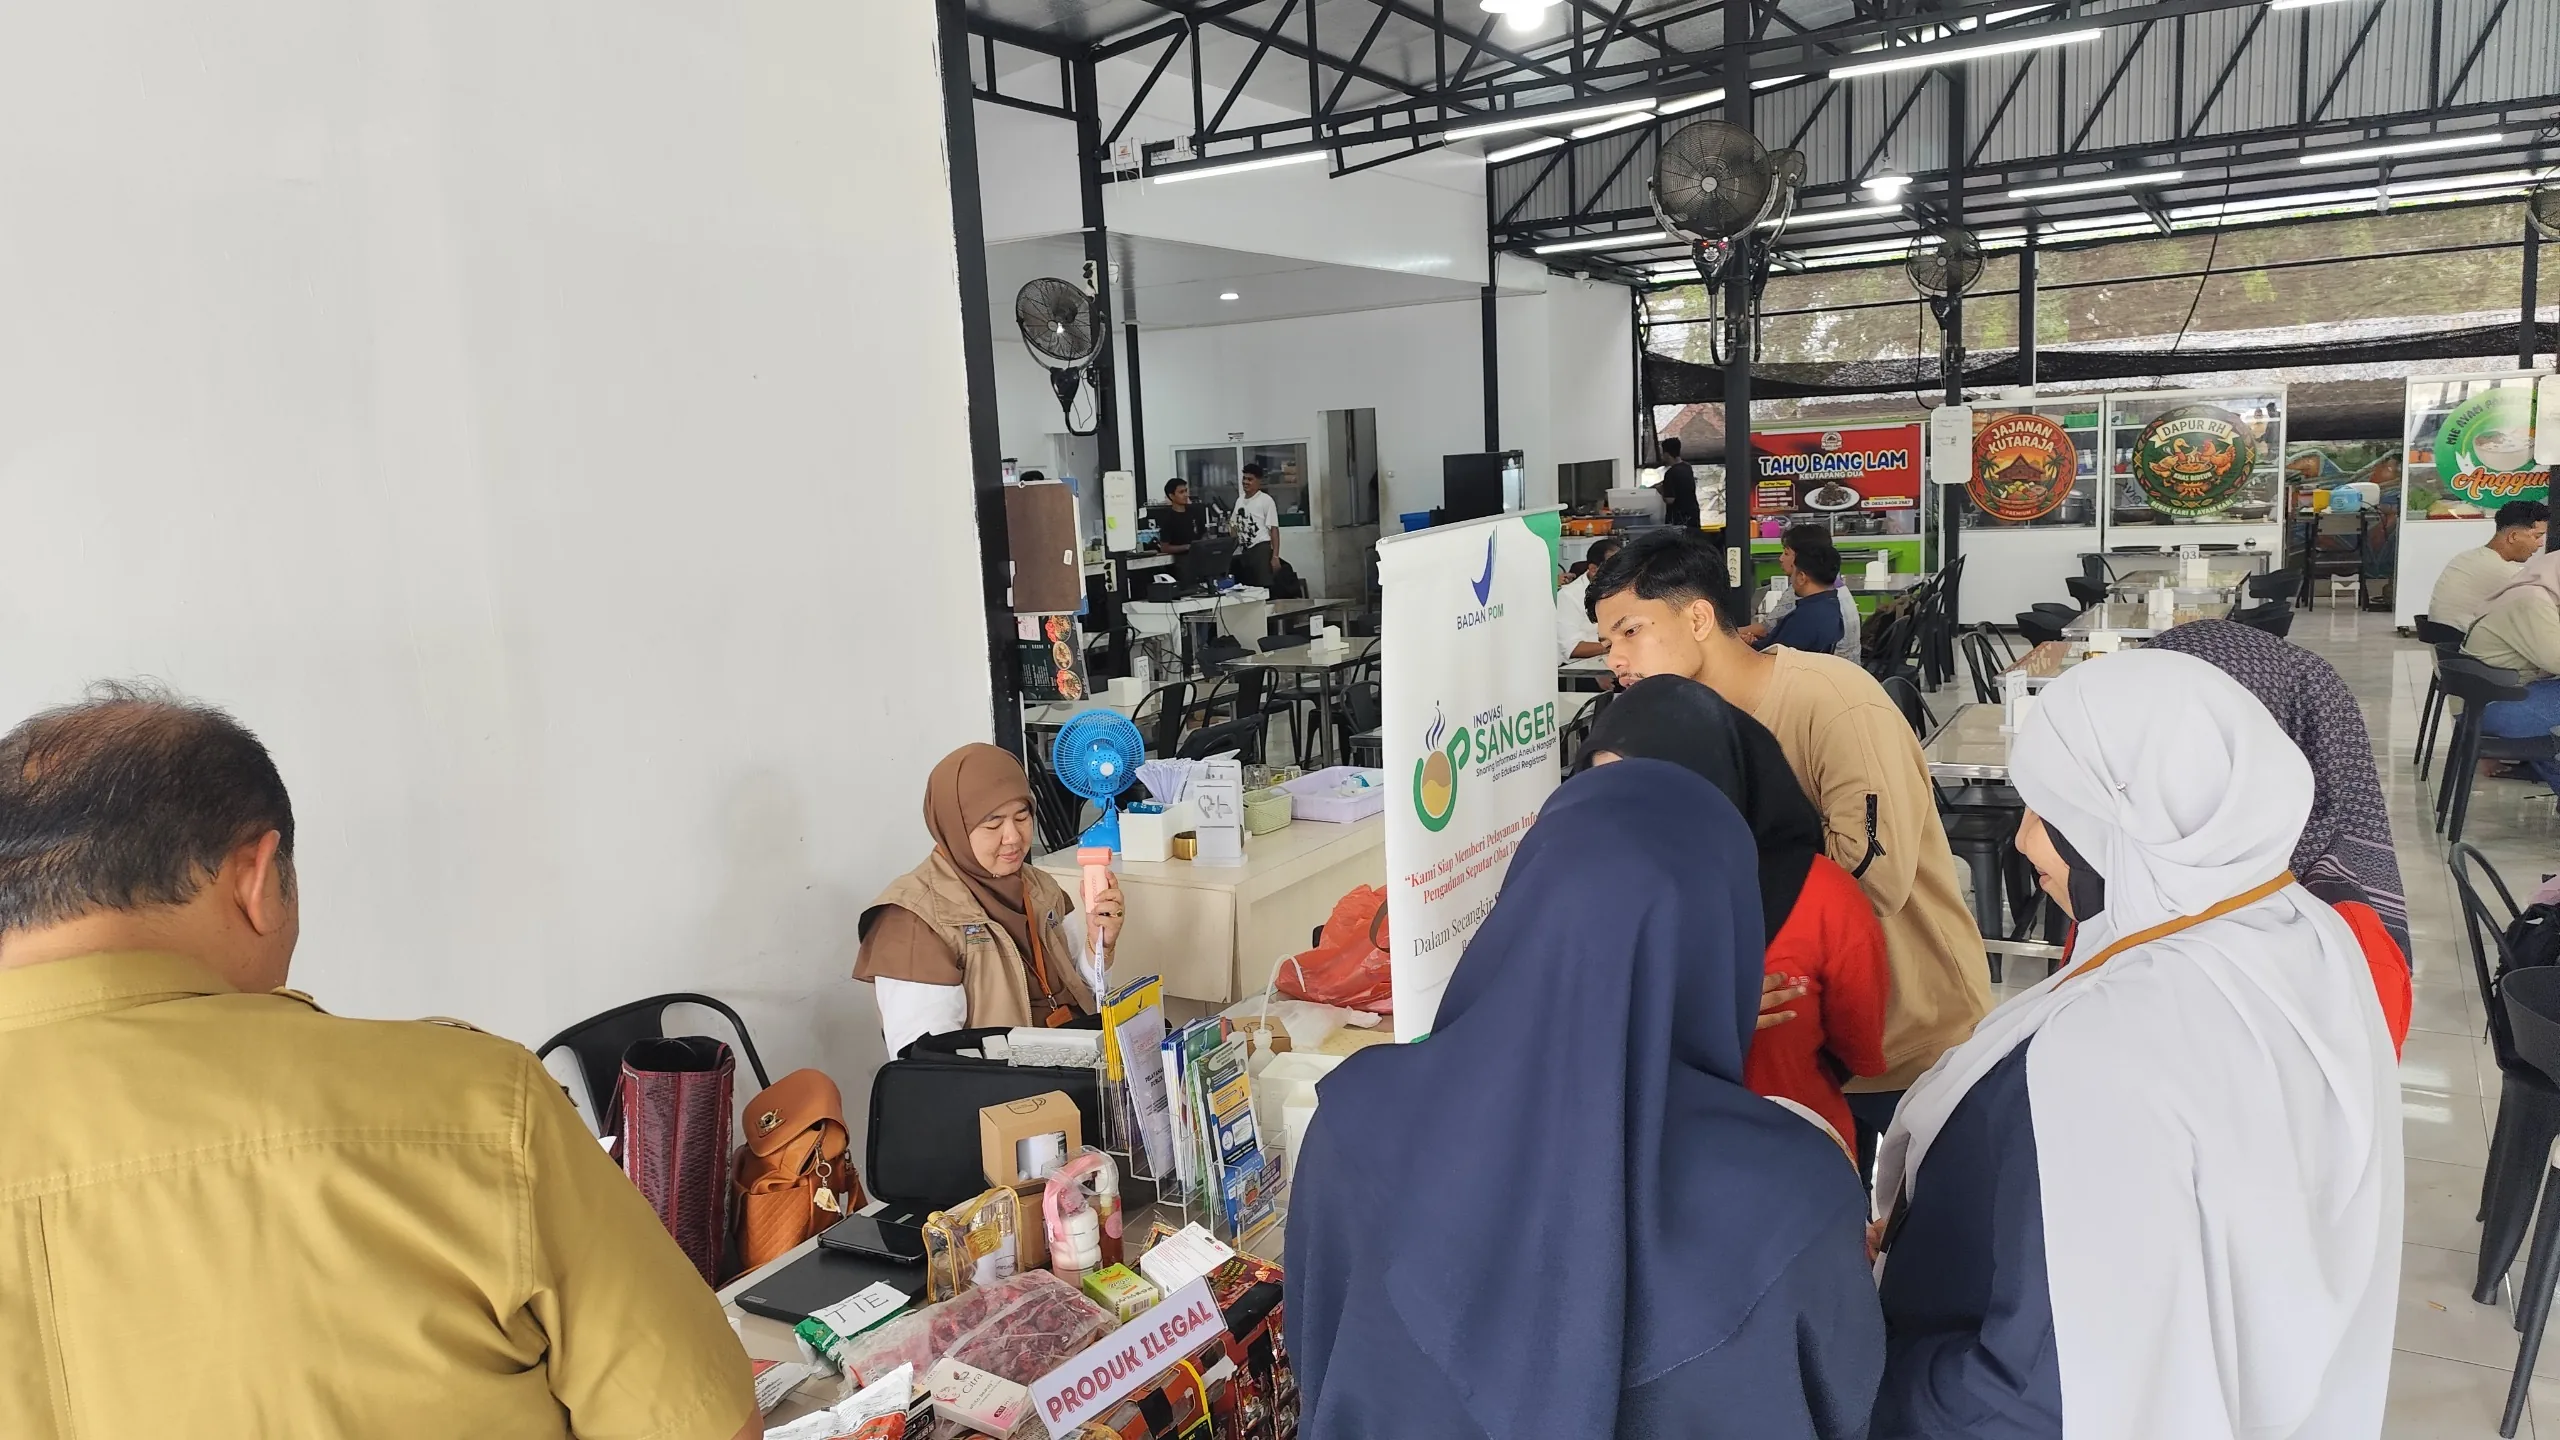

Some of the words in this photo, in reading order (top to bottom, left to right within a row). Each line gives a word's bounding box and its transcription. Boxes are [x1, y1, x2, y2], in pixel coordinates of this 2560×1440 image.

[1991, 420, 2053, 440] JAJANAN
[2162, 419, 2205, 437] DAPUR
[2208, 421, 2227, 435] RH
[2446, 428, 2461, 446] MIE
[1988, 435, 2055, 454] KUTARAJA
[1758, 454, 1809, 476] TAHU
[1811, 452, 1864, 473] BANG
[1865, 449, 1909, 471] LAM
[1799, 472, 1846, 480] KEUTAPANG
[2181, 550, 2197, 561] 03
[1456, 608, 1487, 631] BADAN
[1488, 603, 1504, 620] POM
[1473, 704, 1503, 728] INOVASI
[1475, 701, 1556, 764] SANGER
[1476, 762, 1495, 777] Sharing
[1501, 761, 1521, 777] Edukasi
[1521, 752, 1548, 769] Registrasi
[1437, 858, 1454, 877] Siap
[1454, 836, 1486, 865] Memberi
[1486, 820, 1521, 848] Pelayanan
[1521, 811, 1539, 829] Info
[1423, 871, 1465, 905] Pengaduan
[1465, 855, 1493, 881] Seputar
[1493, 847, 1509, 863] Obat
[1413, 930, 1451, 957] Dalam
[1451, 896, 1494, 937] Secangkir
[824, 1292, 889, 1324] TIE
[1046, 1345, 1145, 1424] PRODUK
[1140, 1300, 1215, 1361] ILEGAL
[962, 1373, 984, 1394] Citra
